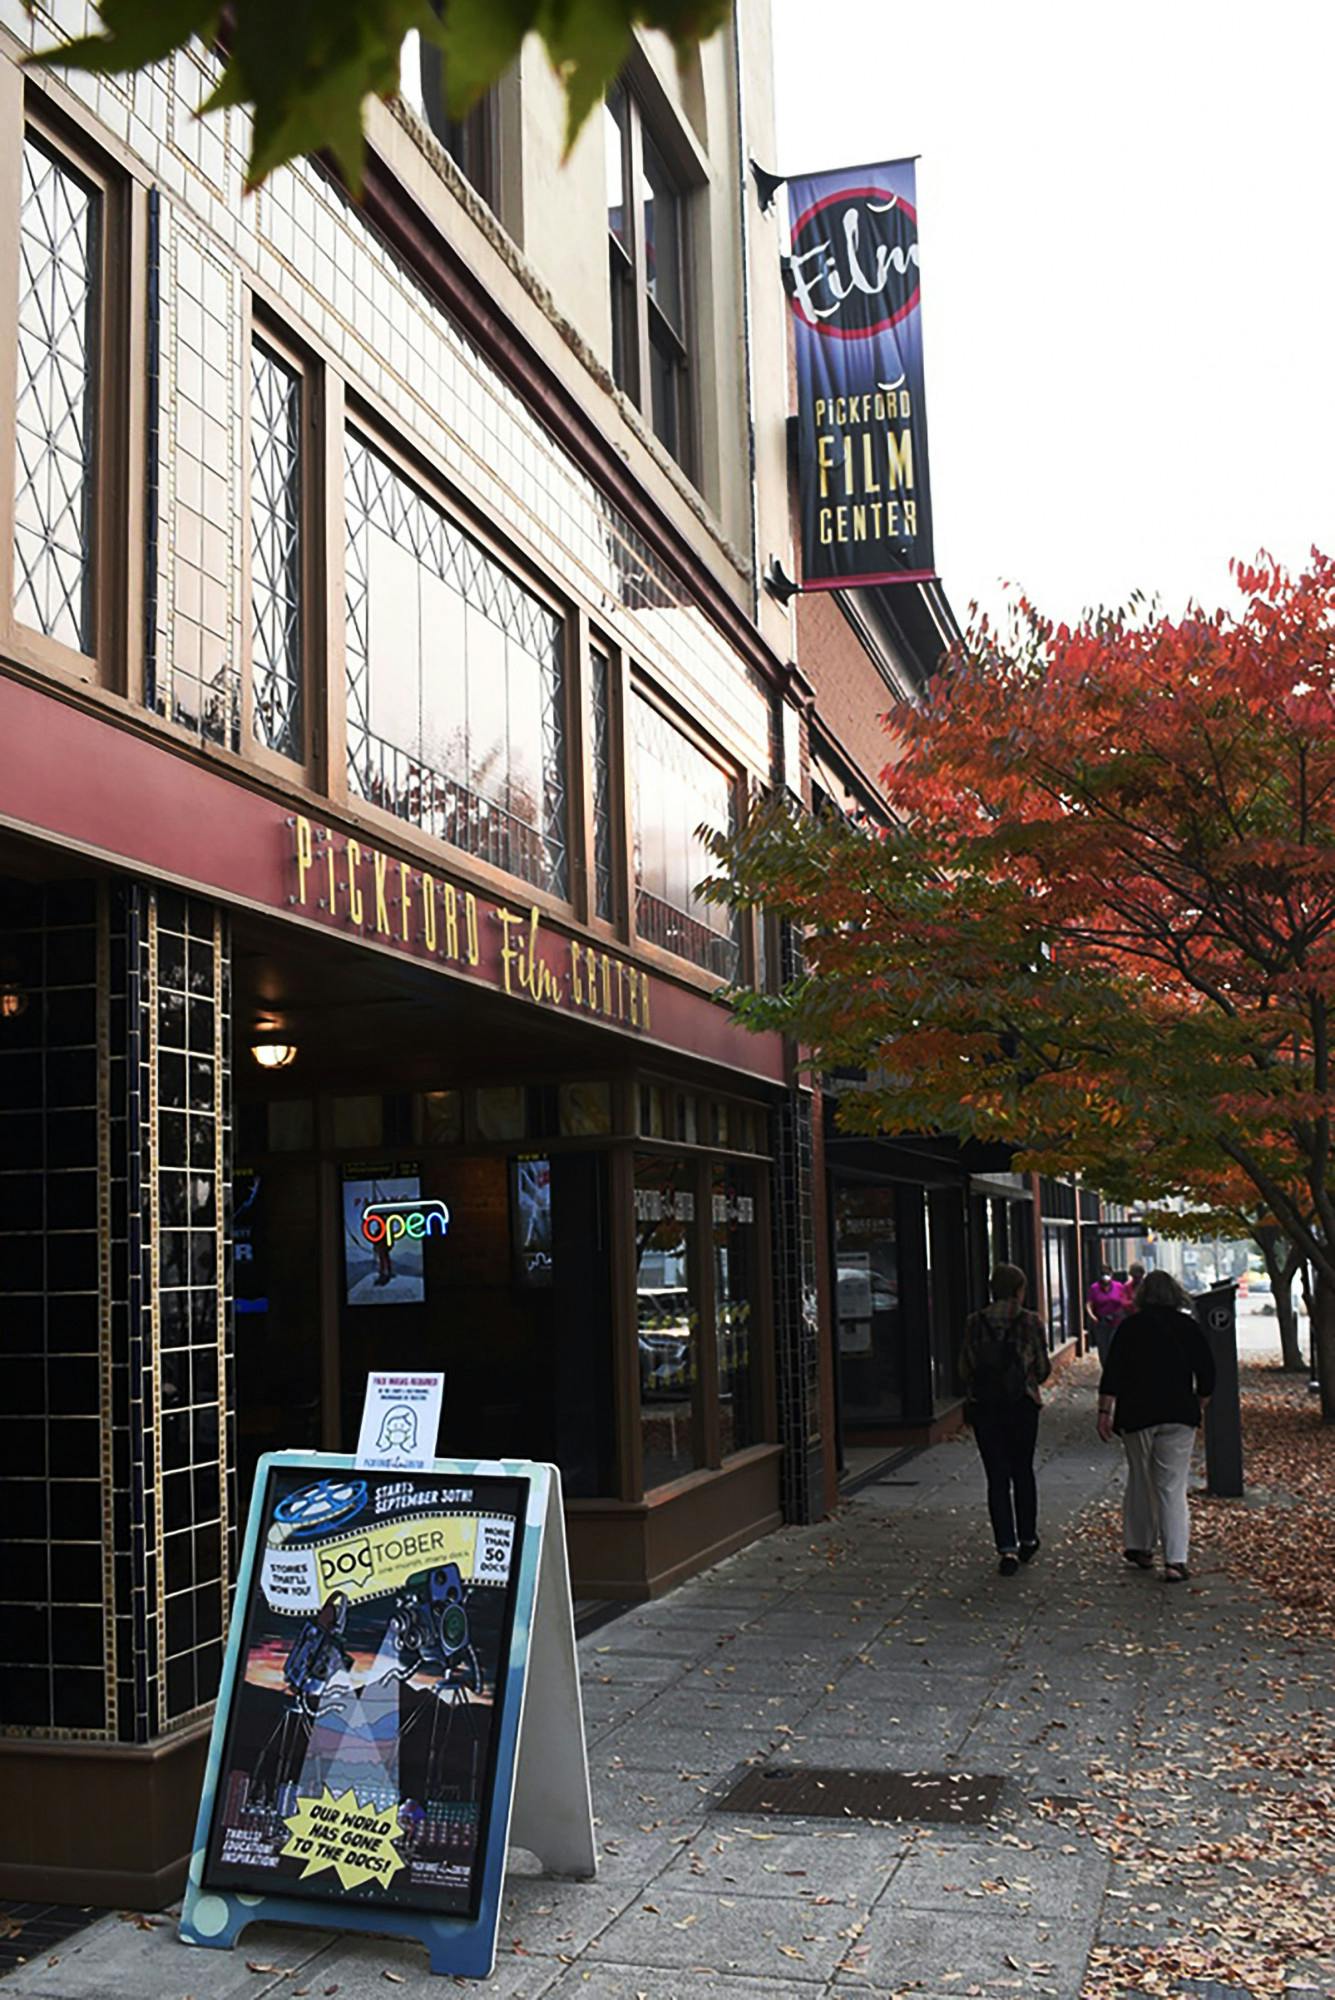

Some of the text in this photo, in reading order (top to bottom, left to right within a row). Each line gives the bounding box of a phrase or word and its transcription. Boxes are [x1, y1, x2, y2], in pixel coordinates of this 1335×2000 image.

[790, 207, 920, 324] Film
[818, 428, 915, 499] FILM
[819, 501, 918, 545] CENTER
[496, 905, 562, 1004] Film
[570, 940, 652, 1031] CENTER
[362, 1211, 449, 1247] open
[374, 1481, 415, 1503] STARTS
[375, 1490, 440, 1515] SEPTEMBER
[484, 1527, 511, 1539] MORE
[484, 1536, 511, 1548] THAN
[270, 1563, 308, 1574] STORIES
[484, 1547, 506, 1563] 50
[269, 1584, 289, 1595] WOW
[309, 1804, 391, 1836] OUR WORLD
[309, 1823, 383, 1852] HAS GONE
[293, 1837, 312, 1852] TO
[316, 1842, 345, 1862] THE
[346, 1847, 392, 1874] DOCS!
